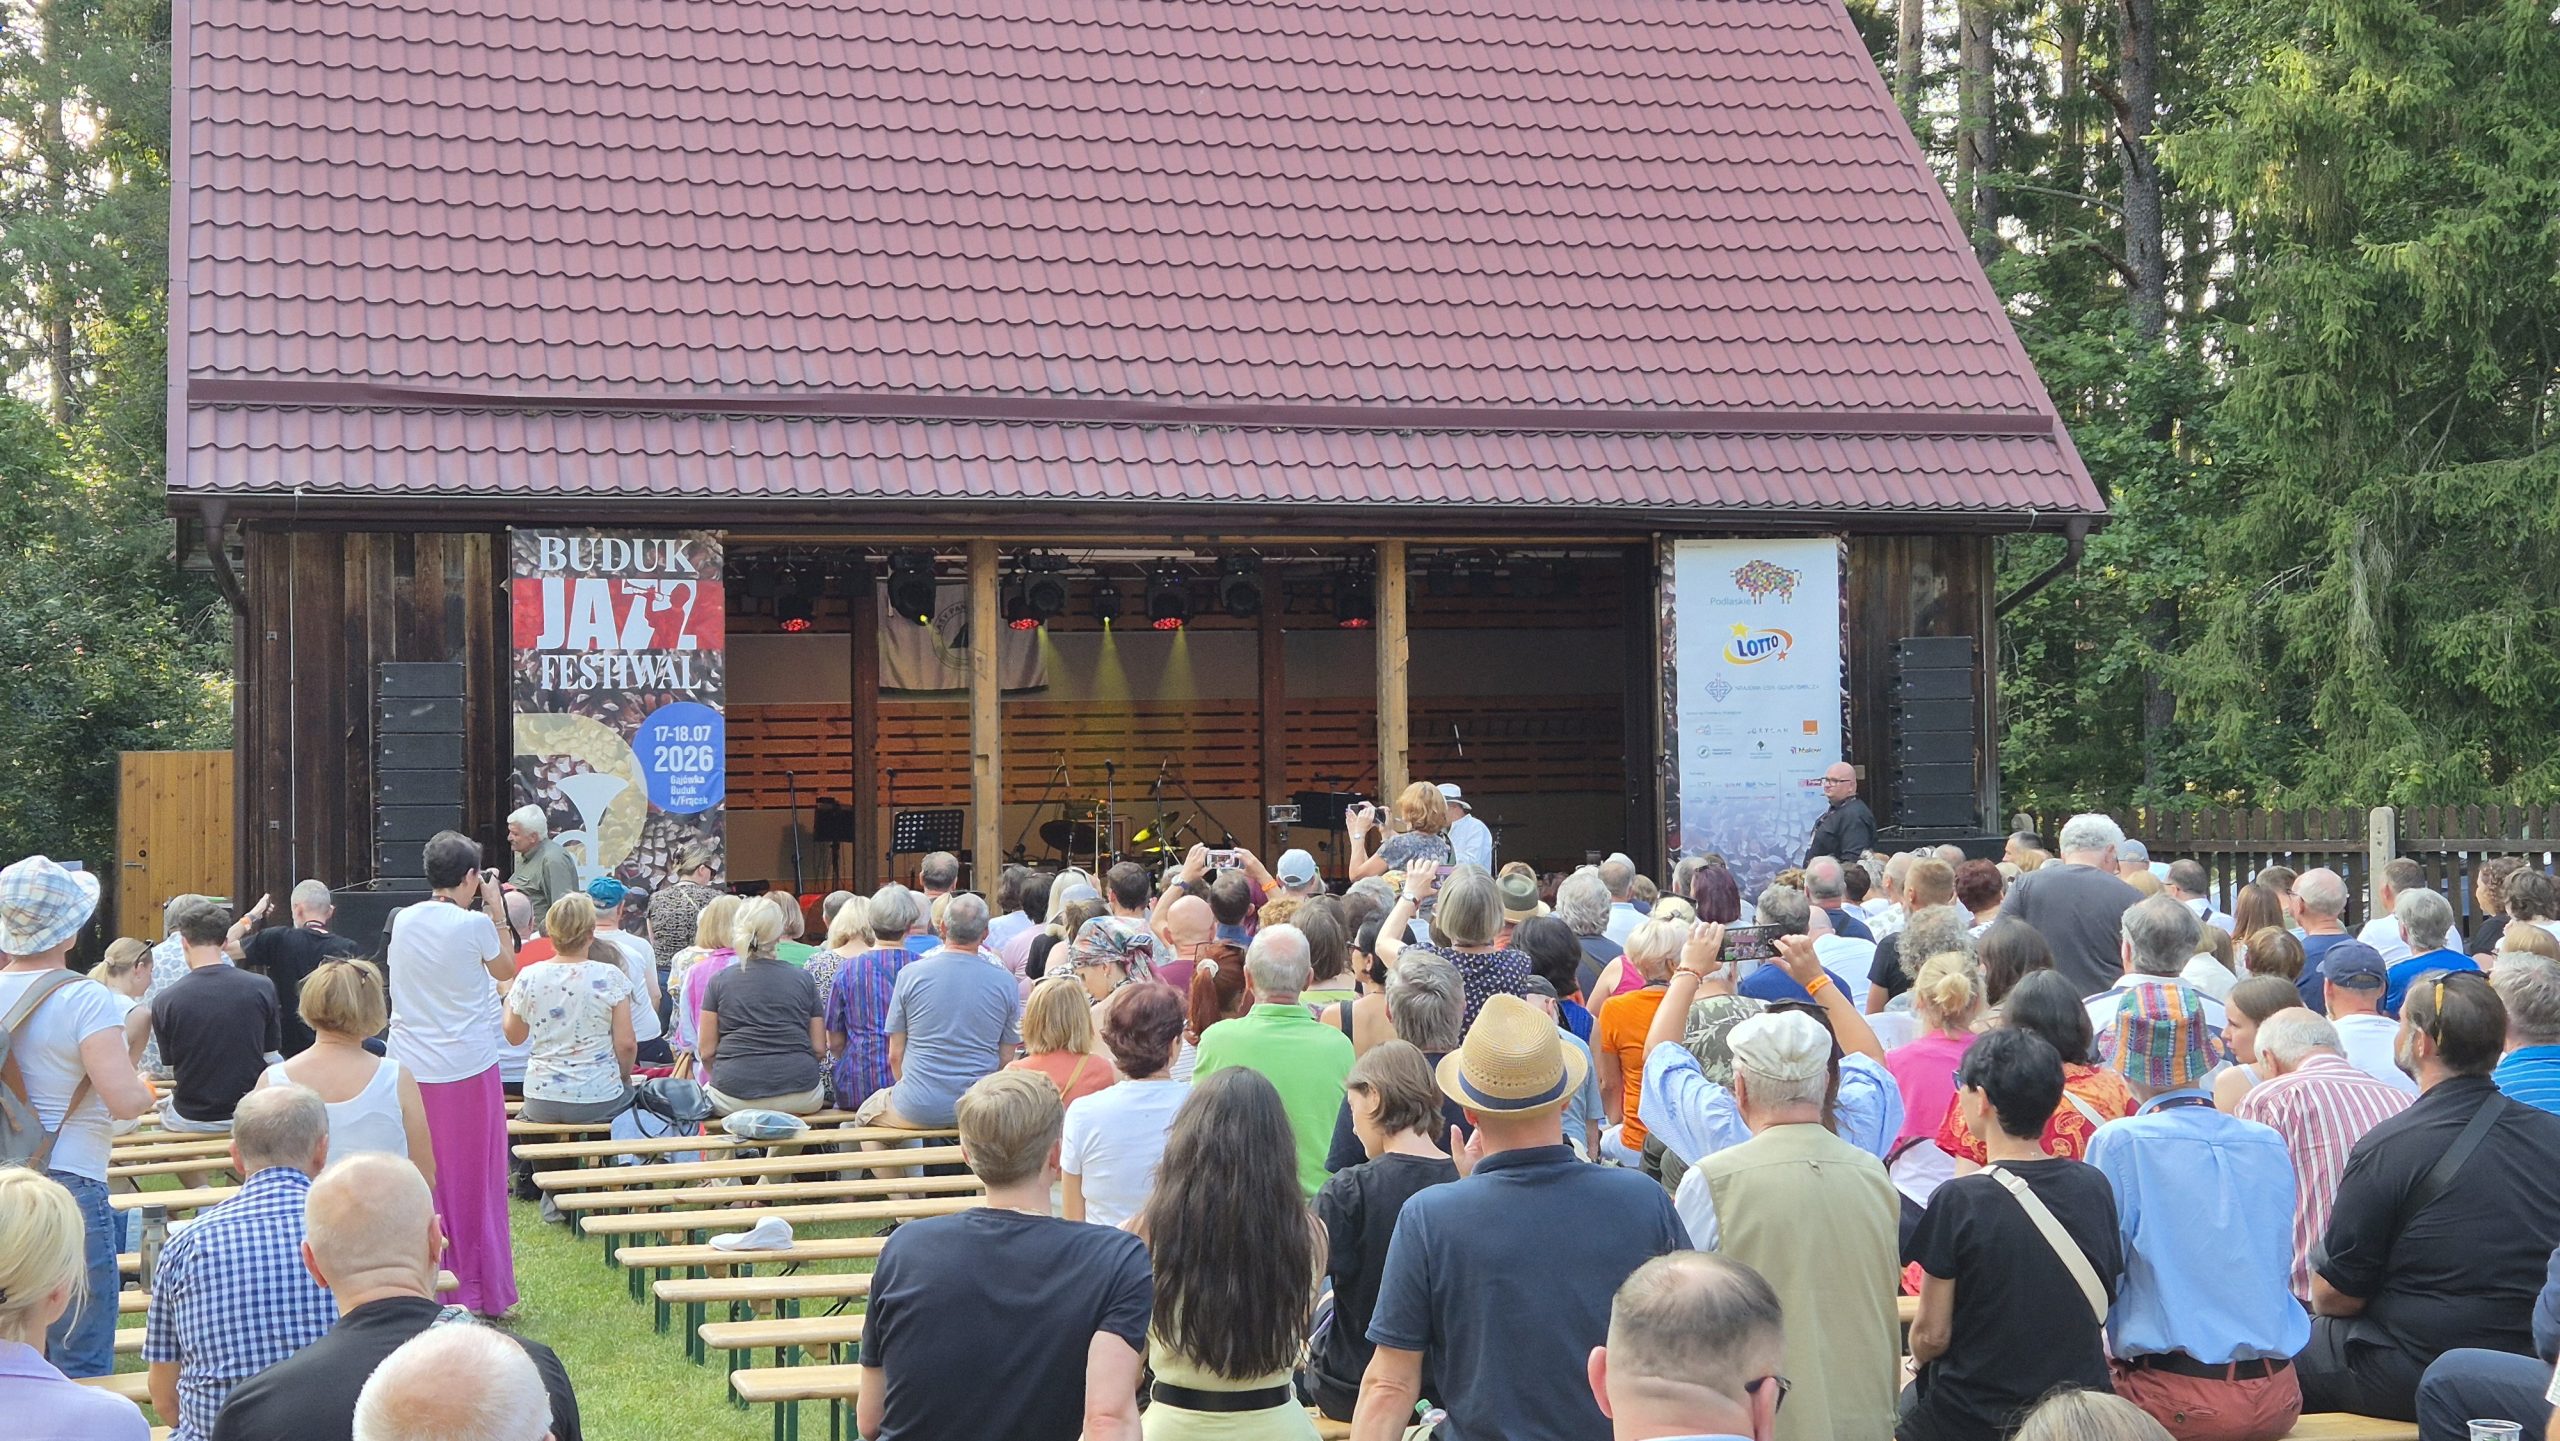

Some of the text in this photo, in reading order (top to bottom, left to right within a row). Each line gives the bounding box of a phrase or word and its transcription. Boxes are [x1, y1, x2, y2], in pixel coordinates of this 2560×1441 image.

[538, 537, 697, 572] BUDUK
[1710, 597, 1751, 605] Podlaskie
[537, 578, 697, 650] JAZZ
[1737, 635, 1779, 657] LOTTO
[541, 654, 701, 690] FESTIWAL
[654, 725, 711, 741] 17-18.07
[654, 745, 714, 772] 2026
[670, 775, 705, 785] Gajówka
[670, 786, 697, 794] Buduk
